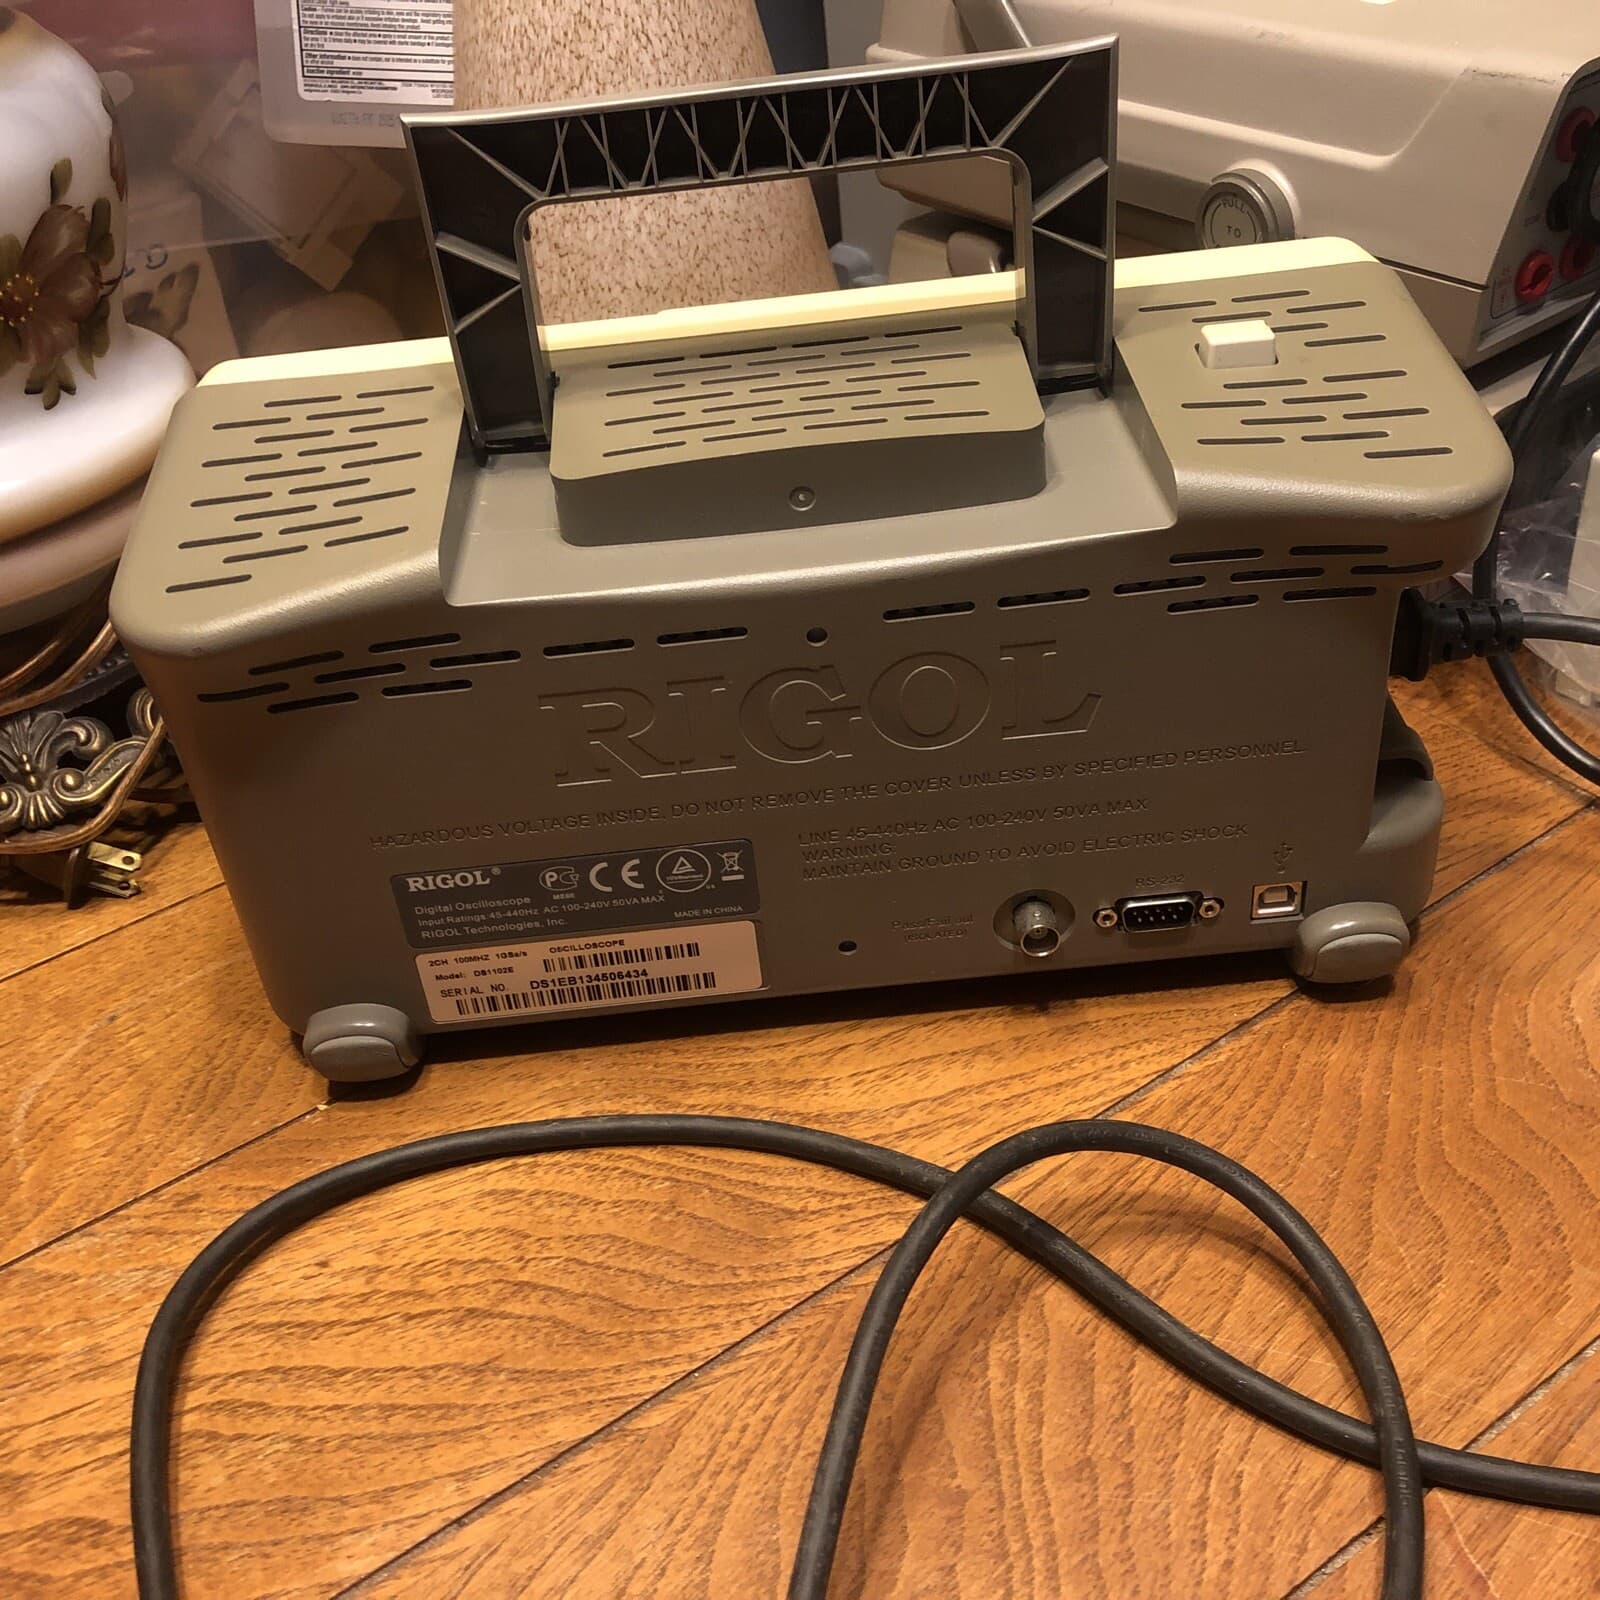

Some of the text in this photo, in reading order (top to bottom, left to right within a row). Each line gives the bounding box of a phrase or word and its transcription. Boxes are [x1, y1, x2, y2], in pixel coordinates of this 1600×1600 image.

[1226, 224, 1242, 239] TO
[537, 640, 1102, 787] RIGOL
[368, 824, 495, 850] HAZARDOUS
[497, 815, 591, 838] VOLTAGE
[671, 802, 700, 819] DO
[704, 797, 745, 816] NOT
[752, 788, 834, 811] REMOVE
[840, 784, 880, 802] THE
[884, 775, 952, 796] COVER
[959, 768, 1036, 789] UNLESS
[1043, 764, 1068, 782] BY
[1074, 752, 1178, 778] SPECIFIED
[1183, 739, 1306, 767] PERSONNEL
[798, 830, 841, 847] LINE
[931, 816, 960, 833] AC
[967, 808, 1048, 829] 100-240V
[1053, 802, 1101, 821] 50VA
[1106, 798, 1149, 816] MAX
[802, 822, 1249, 881] MAINTAIN GROUND TO AVOID ELECTRIC SHOCK
[802, 842, 893, 864] WARNING
[414, 896, 532, 917] Digital Oscilloscope
[417, 916, 445, 928] Input
[543, 905, 560, 914] AC
[562, 899, 610, 912] 100-240V
[612, 896, 640, 907] 50VA
[641, 893, 665, 904] MAX
[674, 905, 744, 919] MADE IN CHINA
[421, 926, 464, 940] RIGOL
[549, 939, 625, 954] OSCILLOSCOPE
[428, 959, 449, 967] 2CH
[454, 954, 490, 965] 100MHZ
[435, 971, 467, 981] Model:
[529, 968, 649, 990] DS1EB134506434
[440, 985, 484, 998] SERIAL
